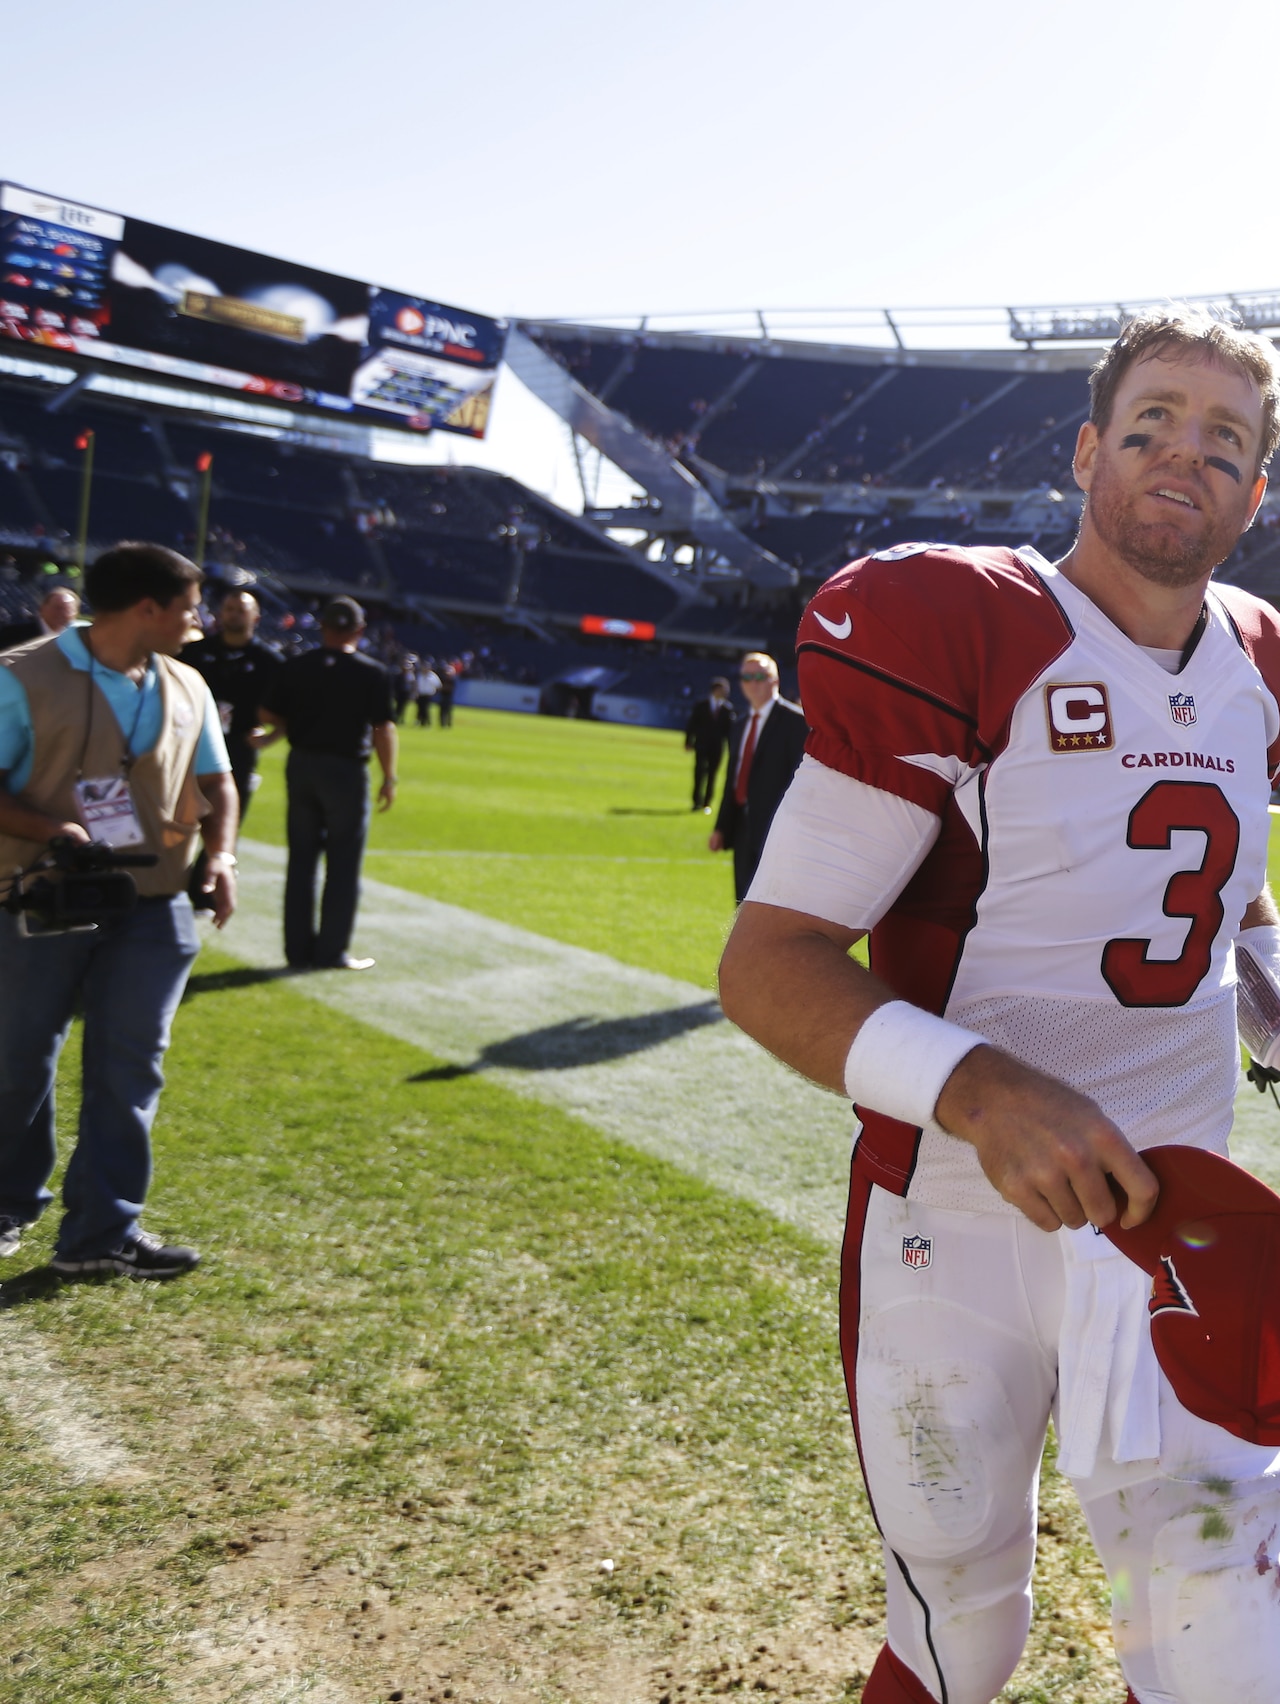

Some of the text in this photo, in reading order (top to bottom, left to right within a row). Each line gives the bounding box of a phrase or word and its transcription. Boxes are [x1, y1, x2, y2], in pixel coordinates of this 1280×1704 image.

[424, 313, 478, 349] PNC
[1050, 686, 1106, 734] C
[1172, 707, 1195, 724] NFL
[1121, 751, 1235, 773] CARDINALS
[1100, 779, 1241, 1008] 3
[905, 1249, 928, 1265] NFL
